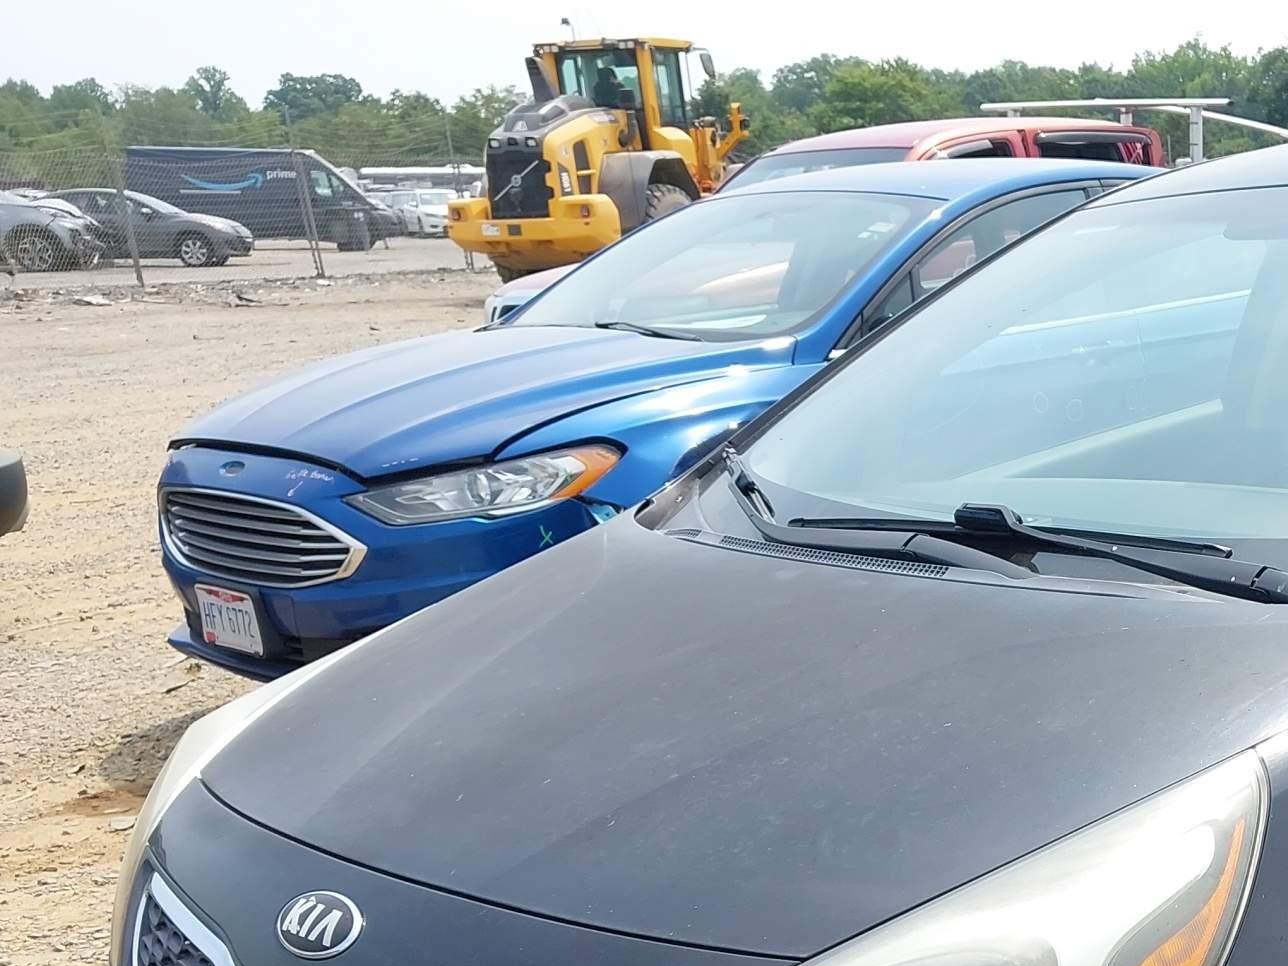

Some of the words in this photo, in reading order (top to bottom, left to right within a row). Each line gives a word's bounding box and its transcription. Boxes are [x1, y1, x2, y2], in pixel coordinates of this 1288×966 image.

[266, 169, 297, 179] prime
[202, 600, 225, 632] HFY
[226, 606, 256, 639] 6772
[281, 896, 344, 948] KIA
